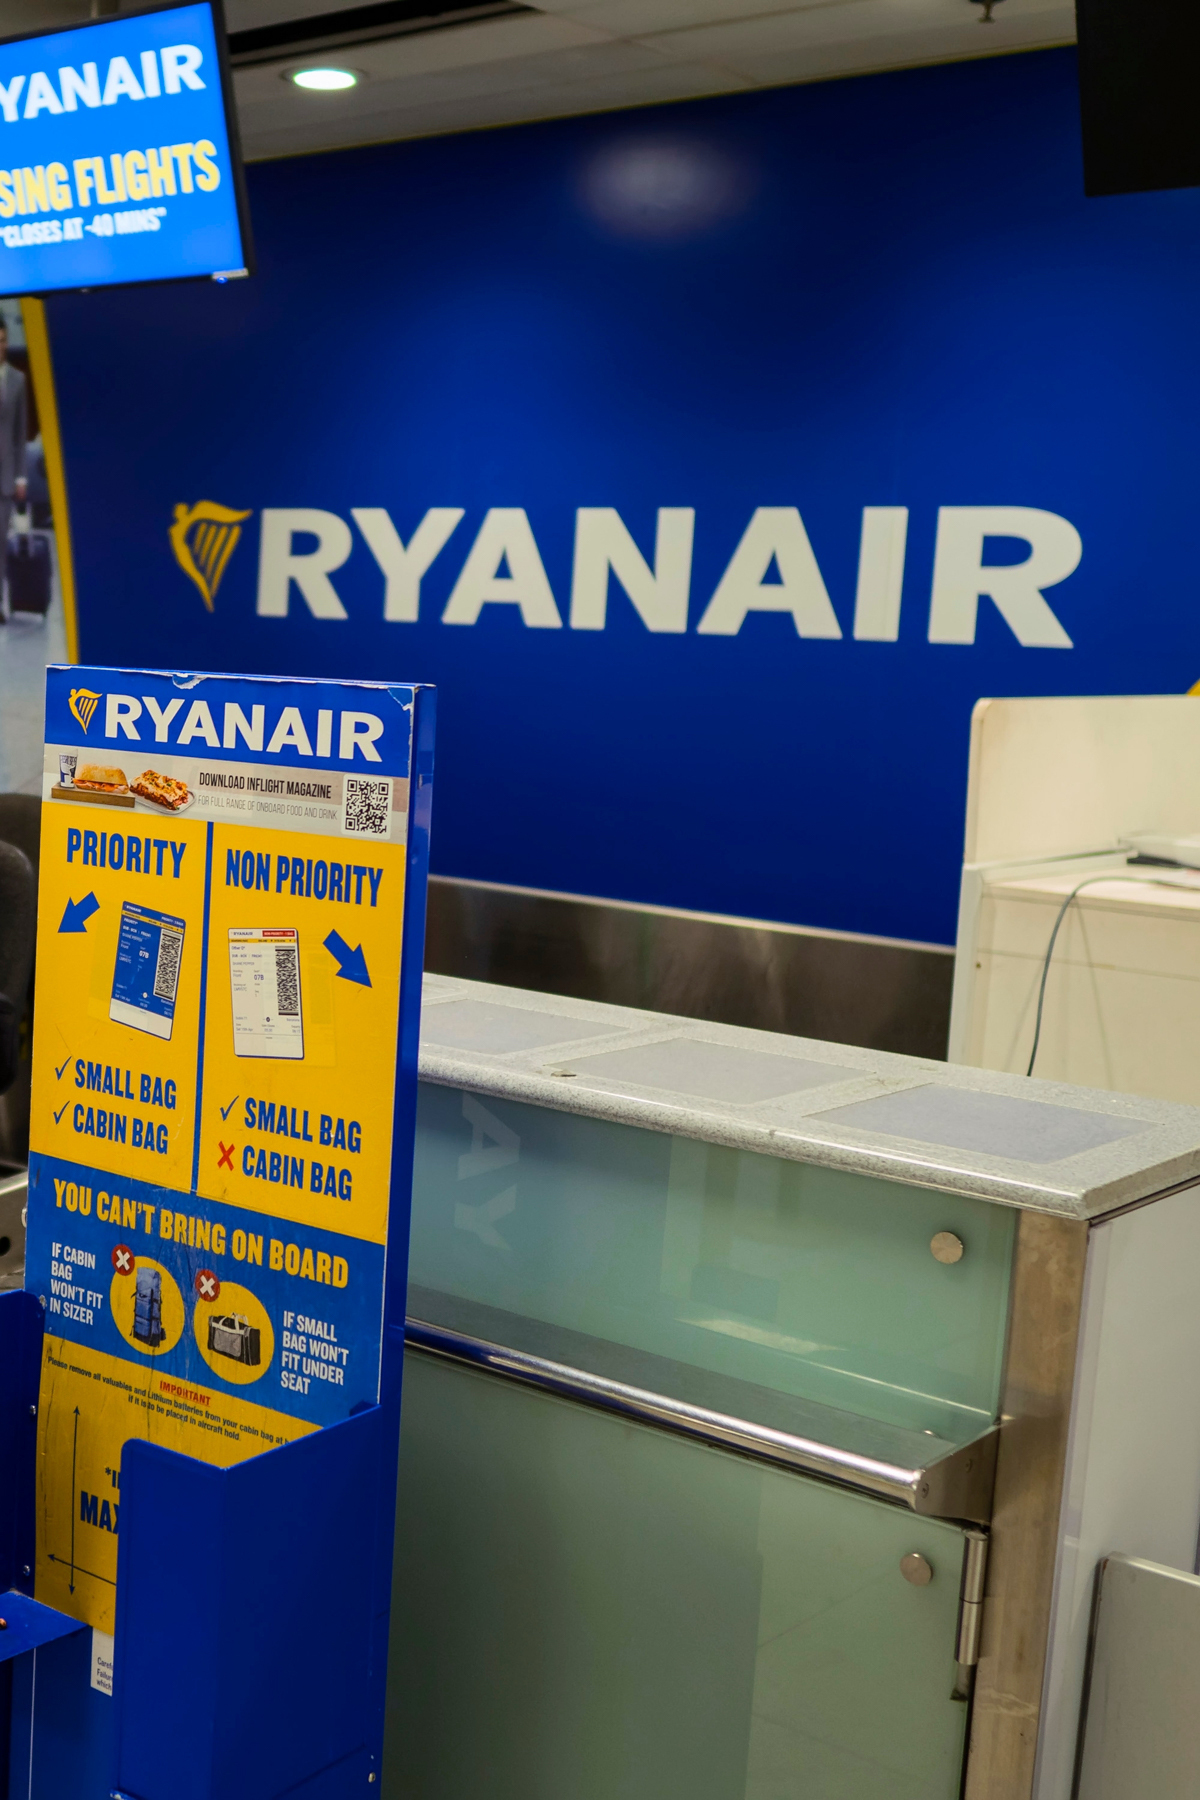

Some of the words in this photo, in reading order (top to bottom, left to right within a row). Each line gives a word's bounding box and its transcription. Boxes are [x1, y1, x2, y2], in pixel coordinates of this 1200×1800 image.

[73, 139, 221, 207] FLIGHTS
[63, 217, 84, 241] AT
[256, 505, 1083, 649] RYANAIR
[104, 693, 386, 763] RYANAIR
[199, 772, 245, 790] DOWNLOAD
[247, 777, 285, 794] INFLIGHT
[286, 781, 332, 799] MAGAZINE
[198, 794, 210, 806] FOR
[211, 796, 225, 808] FULL
[226, 797, 246, 811] RANGE
[247, 800, 255, 811] OF
[256, 801, 285, 815] ONBOARD
[286, 804, 303, 816] FOOD
[304, 806, 317, 818] AND
[319, 807, 338, 820] DRINK
[66, 827, 187, 879] PRIORITY
[225, 848, 271, 890] NON
[276, 855, 384, 907] PRIORITY
[74, 1058, 135, 1100] SMALL
[139, 1073, 177, 1110] BAG
[73, 1103, 127, 1144] CABIN
[131, 1117, 169, 1155] BAG
[244, 1097, 314, 1143] SMALL
[319, 1114, 362, 1154] BAG
[242, 1145, 304, 1189] CABIN
[310, 1161, 353, 1202] BAG
[53, 1178, 92, 1216] YOU
[96, 1190, 155, 1234] CAN'T
[159, 1208, 226, 1256] BRING
[232, 1229, 263, 1266] ON
[269, 1239, 349, 1289] BOARD
[51, 1260, 72, 1281] BAG
[52, 1242, 62, 1258] IF
[63, 1246, 96, 1270] CABIN
[50, 1297, 61, 1314] IN
[63, 1301, 93, 1325] SIZER
[51, 1278, 85, 1303] WON'T
[86, 1290, 103, 1309] FIT
[283, 1310, 295, 1328] IF
[296, 1314, 337, 1342] SMALL
[283, 1331, 306, 1353] BAG
[309, 1338, 349, 1366] WON'T
[281, 1370, 311, 1395] SEAT
[282, 1350, 300, 1371] FIT
[302, 1357, 344, 1386] UNDER
[48, 1356, 67, 1369] Please
[69, 1365, 91, 1378] remove
[93, 1373, 101, 1381] all
[102, 1376, 132, 1392] valuables
[134, 1387, 146, 1396] and
[147, 1391, 172, 1405] Lithium
[174, 1400, 203, 1416] batteries
[205, 1411, 221, 1422] from
[222, 1418, 238, 1429] your
[240, 1424, 259, 1436] cabin
[261, 1431, 274, 1443] bag
[276, 1437, 283, 1445] at
[160, 1380, 211, 1406] IMPORTANT
[141, 1399, 147, 1408] is
[148, 1401, 155, 1410] to
[156, 1404, 164, 1414] be
[166, 1409, 188, 1422] placed
[190, 1416, 196, 1425] in
[198, 1420, 223, 1435] aircraft
